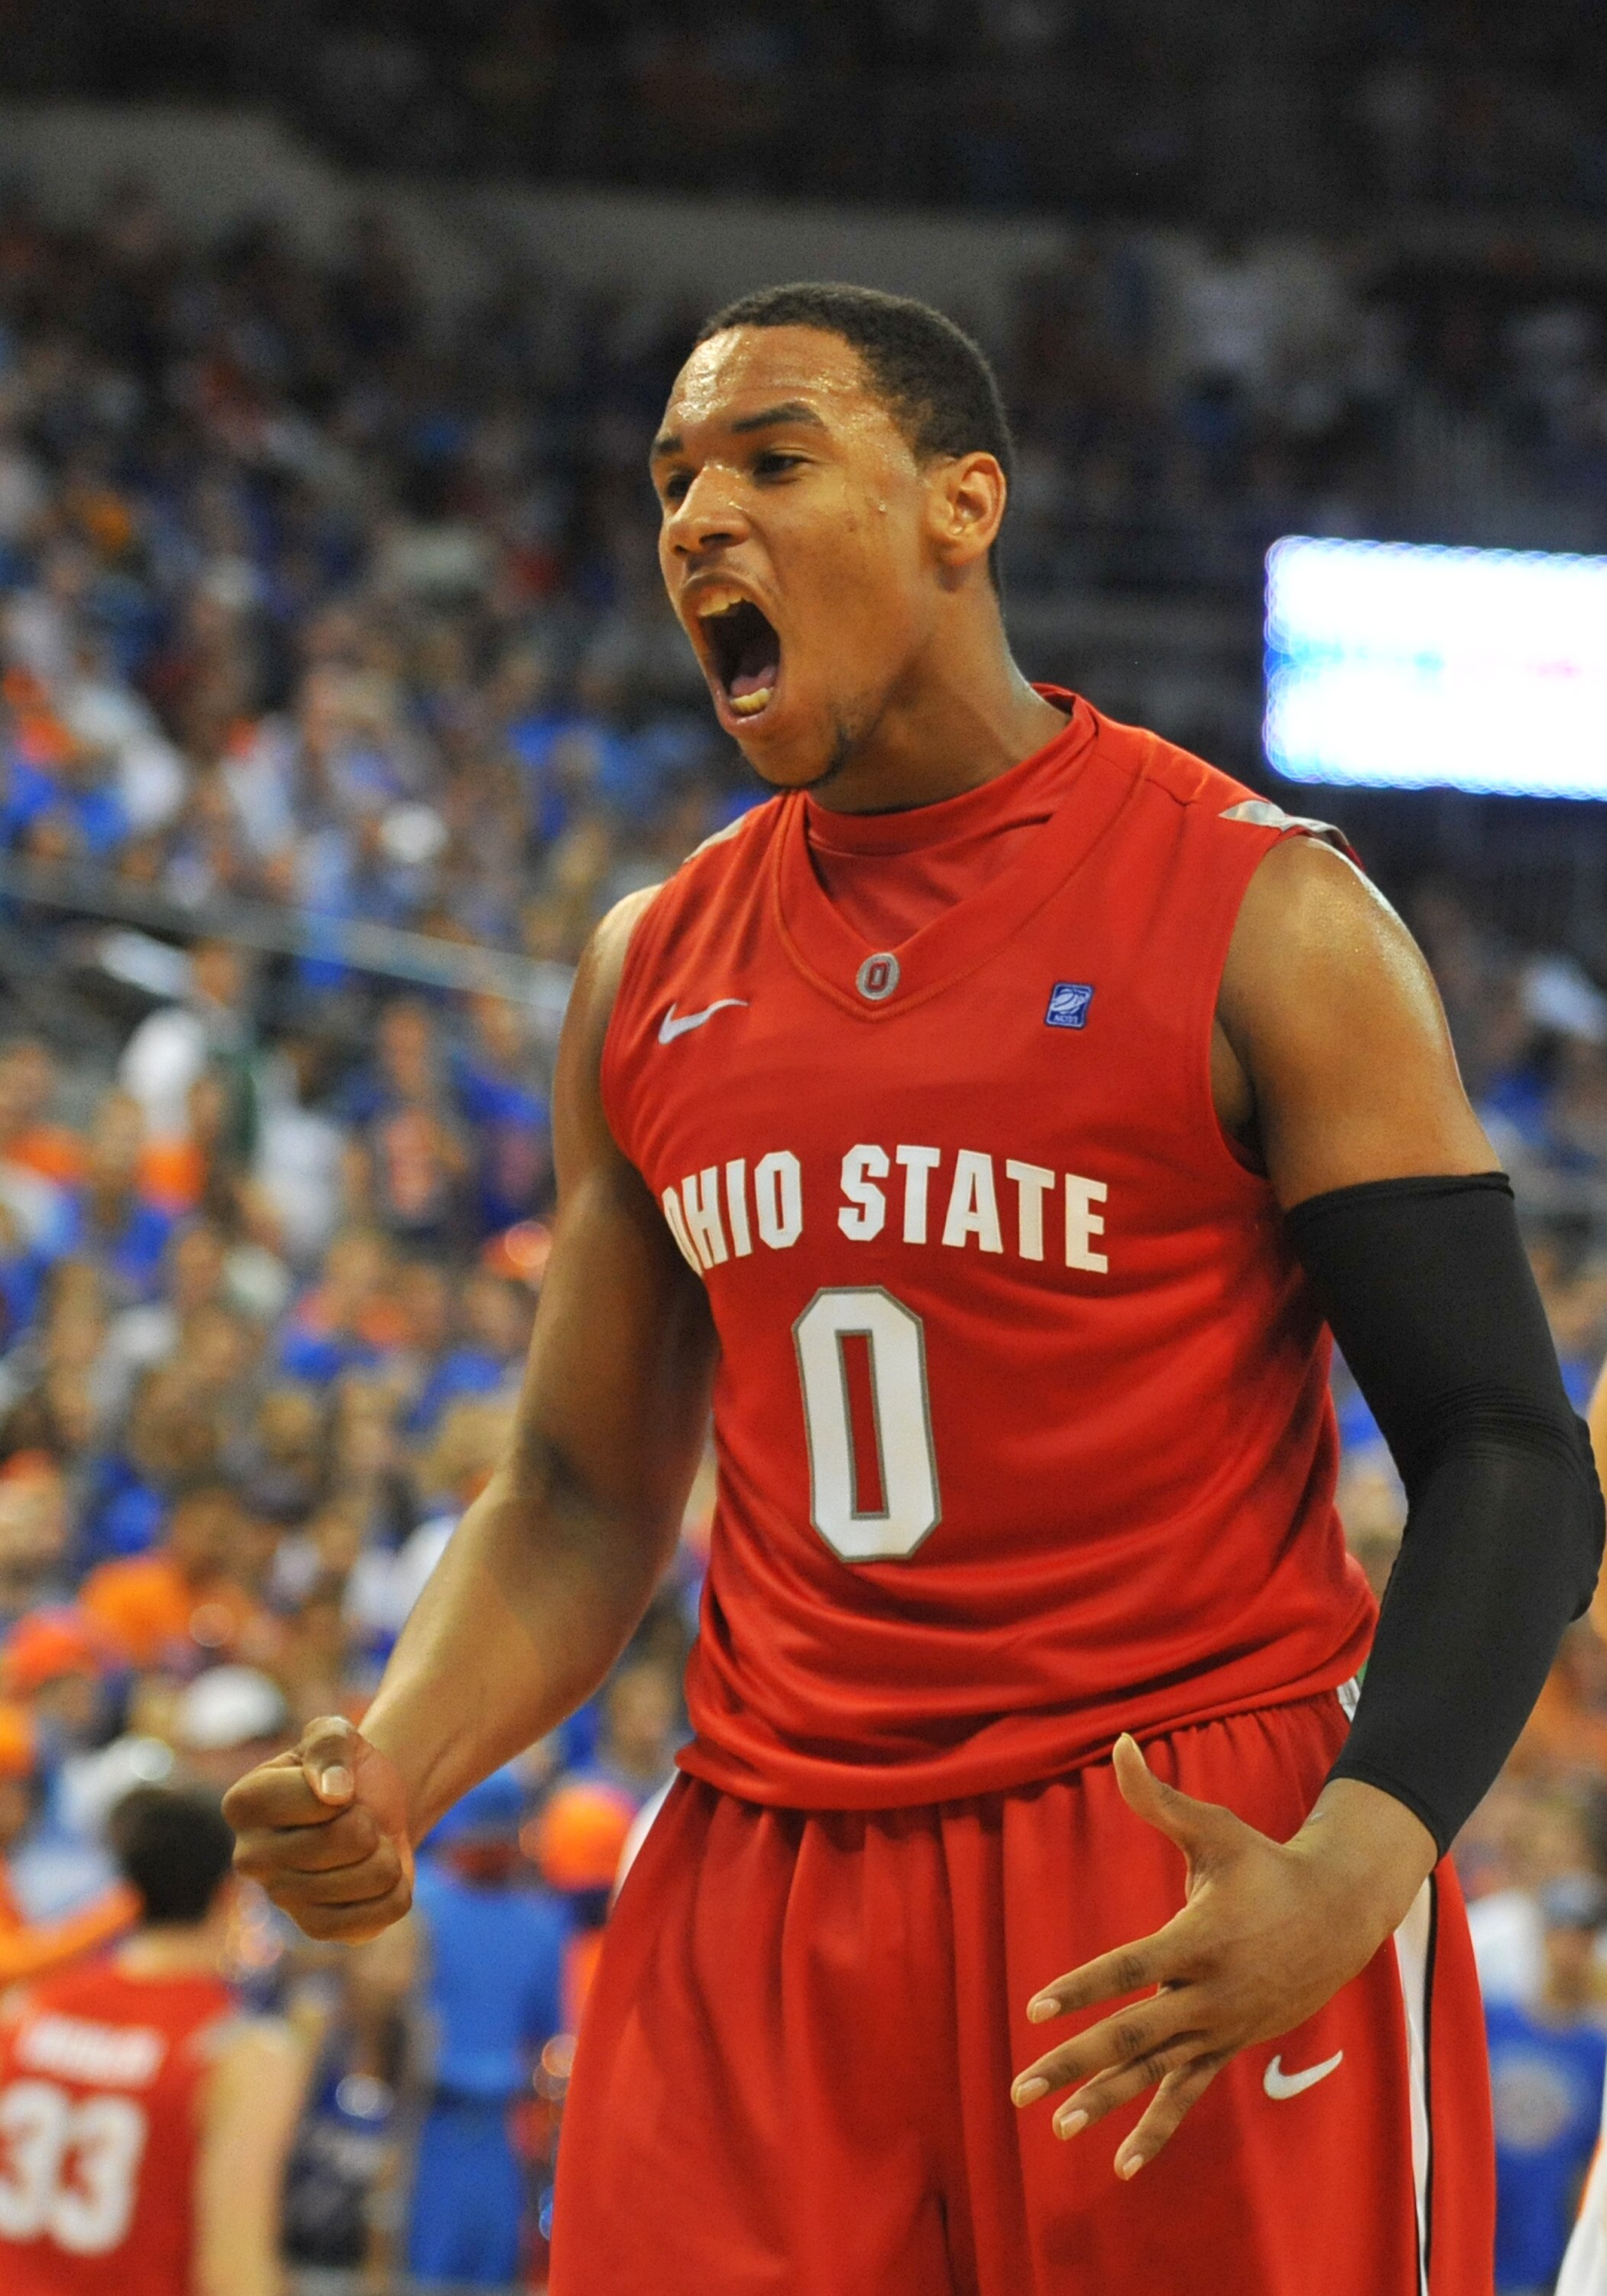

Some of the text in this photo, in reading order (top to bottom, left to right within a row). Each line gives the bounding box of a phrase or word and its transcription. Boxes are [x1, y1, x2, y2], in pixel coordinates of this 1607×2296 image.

[662, 1144, 1108, 1276] OHIO STATE
[791, 1285, 942, 1563] 0
[0, 2077, 149, 2257] 33
